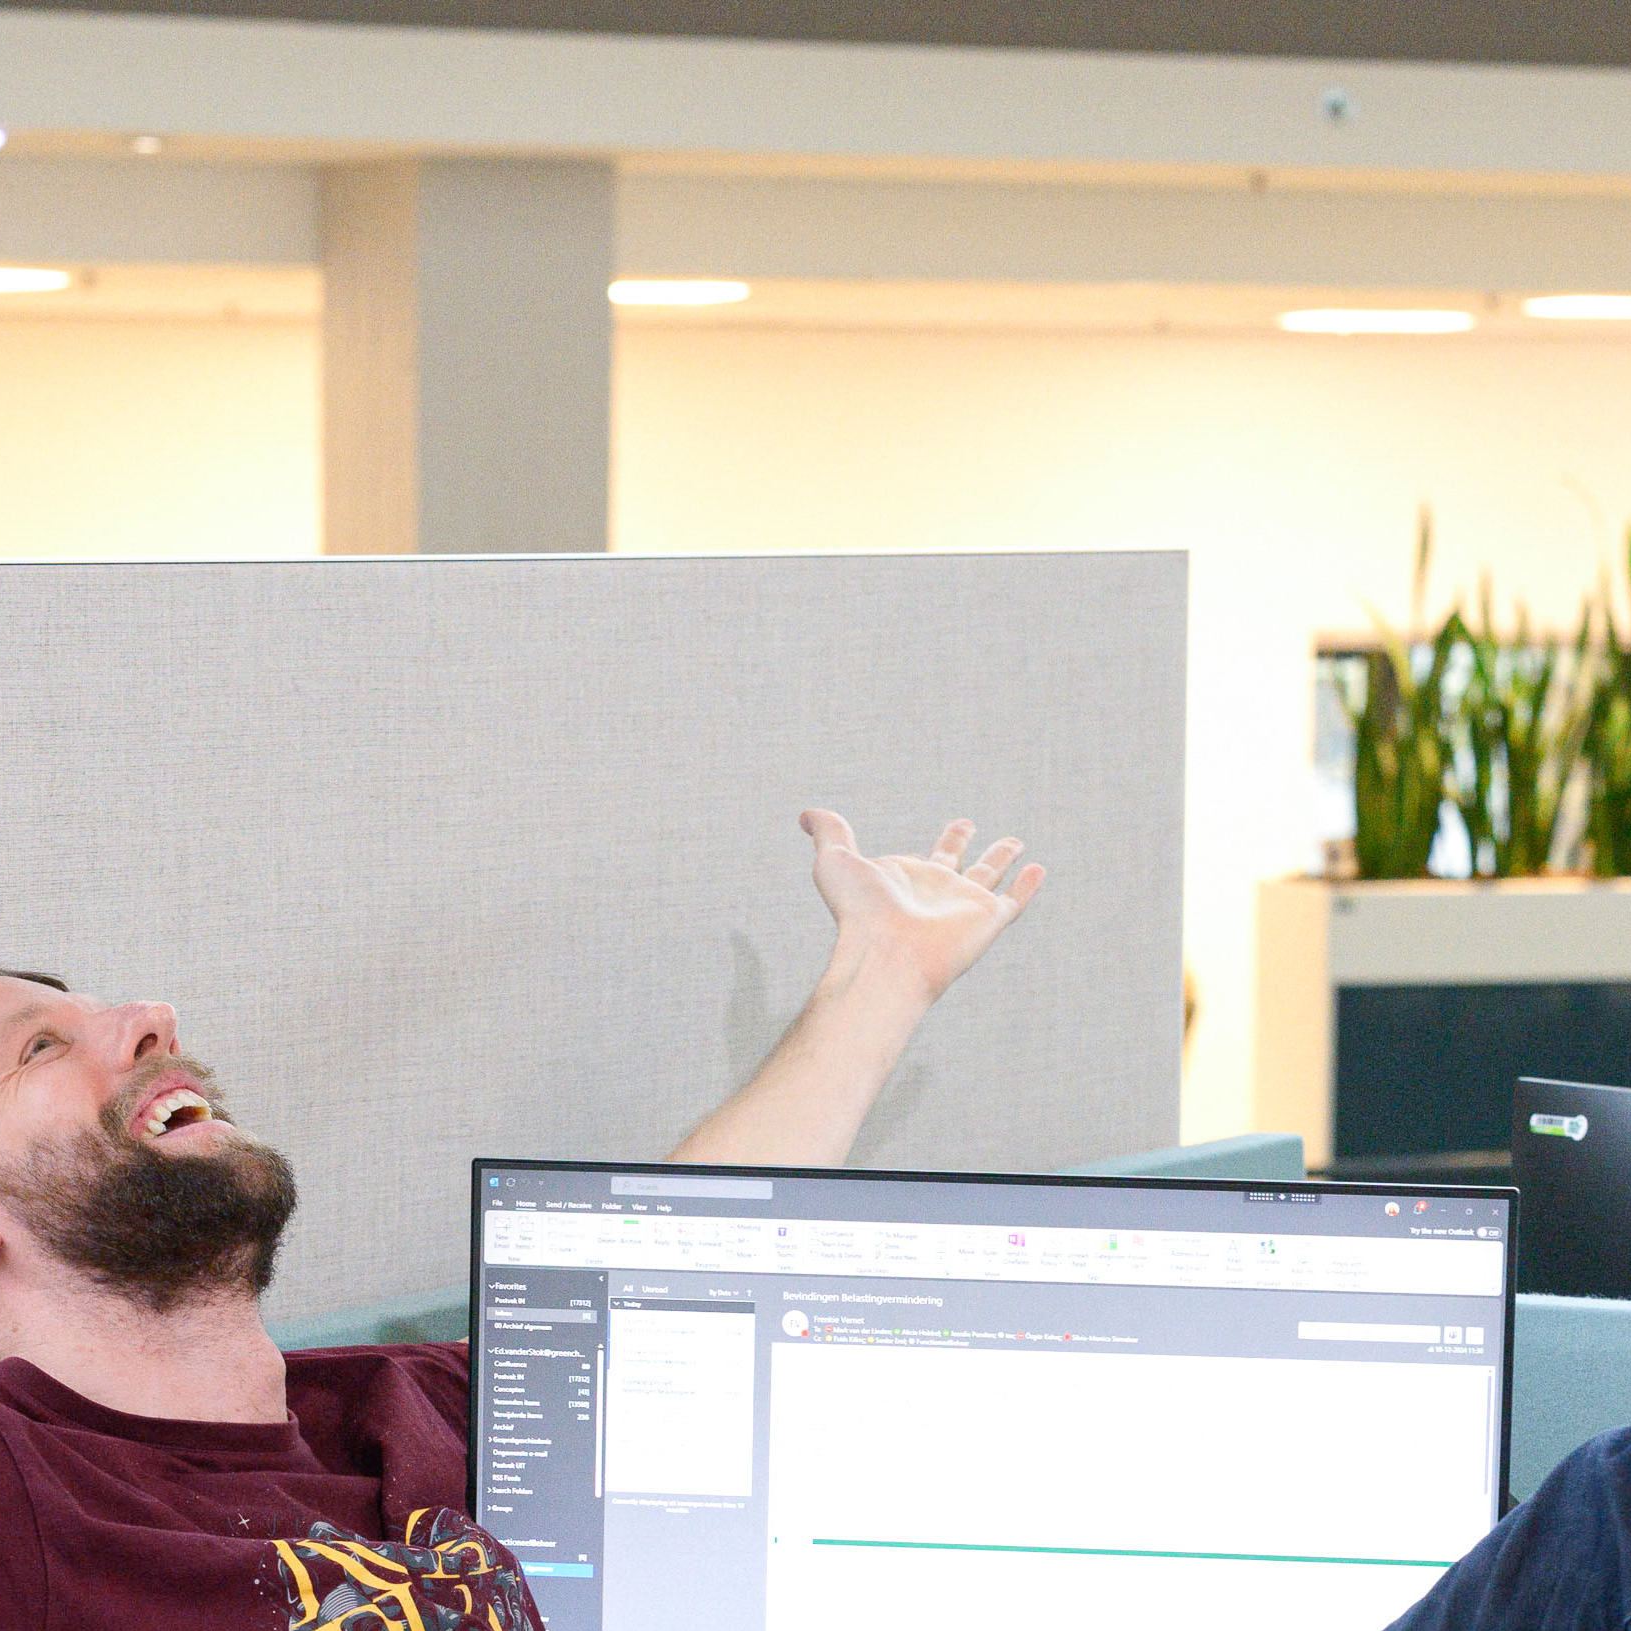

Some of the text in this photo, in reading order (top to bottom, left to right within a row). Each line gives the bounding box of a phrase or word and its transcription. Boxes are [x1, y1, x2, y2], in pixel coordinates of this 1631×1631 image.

[492, 1199, 503, 1207] File
[516, 1200, 536, 1208] Home
[546, 1201, 562, 1209] Send
[568, 1202, 592, 1210] Receive
[657, 1205, 672, 1213] Help
[495, 1282, 527, 1291] Favorites
[642, 1285, 669, 1294] Unread
[783, 1291, 943, 1307] Bevindingen Belastingvermindering
